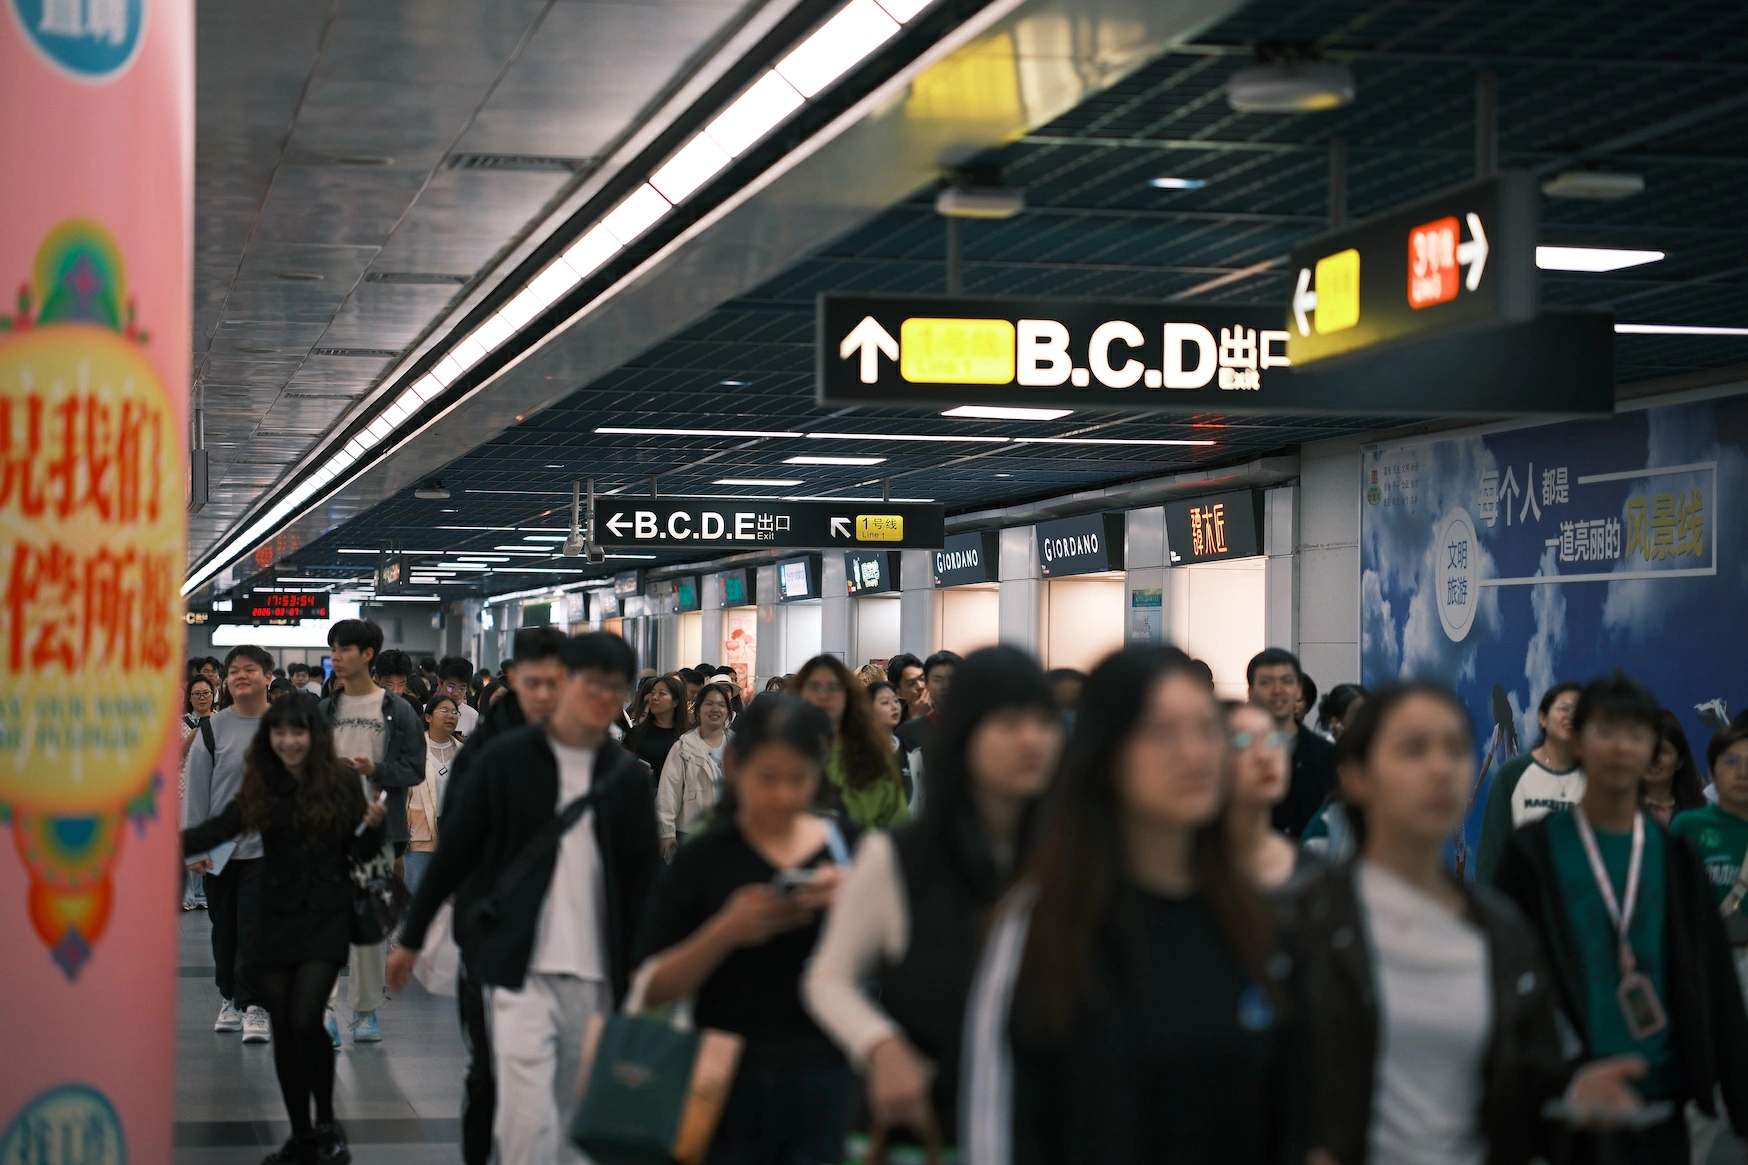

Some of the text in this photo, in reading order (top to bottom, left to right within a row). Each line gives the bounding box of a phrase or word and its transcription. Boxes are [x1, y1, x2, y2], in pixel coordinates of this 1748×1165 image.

[1016, 319, 1292, 389] B.C.D 出口
[1218, 367, 1261, 391] Exit
[1478, 462, 1570, 529] 每个人都是
[634, 510, 791, 540] B.C.D.E 出口
[757, 531, 775, 541] Exit
[862, 518, 898, 531] 1号线
[862, 531, 886, 540] Line 1
[1545, 489, 1705, 562] 一道亮丽的风景线
[936, 549, 979, 574] GIORDANO
[1044, 533, 1099, 562] GIORDANO
[1447, 540, 1468, 570] 文明
[267, 594, 315, 607] 17:53:54
[1446, 577, 1468, 606] 旅游
